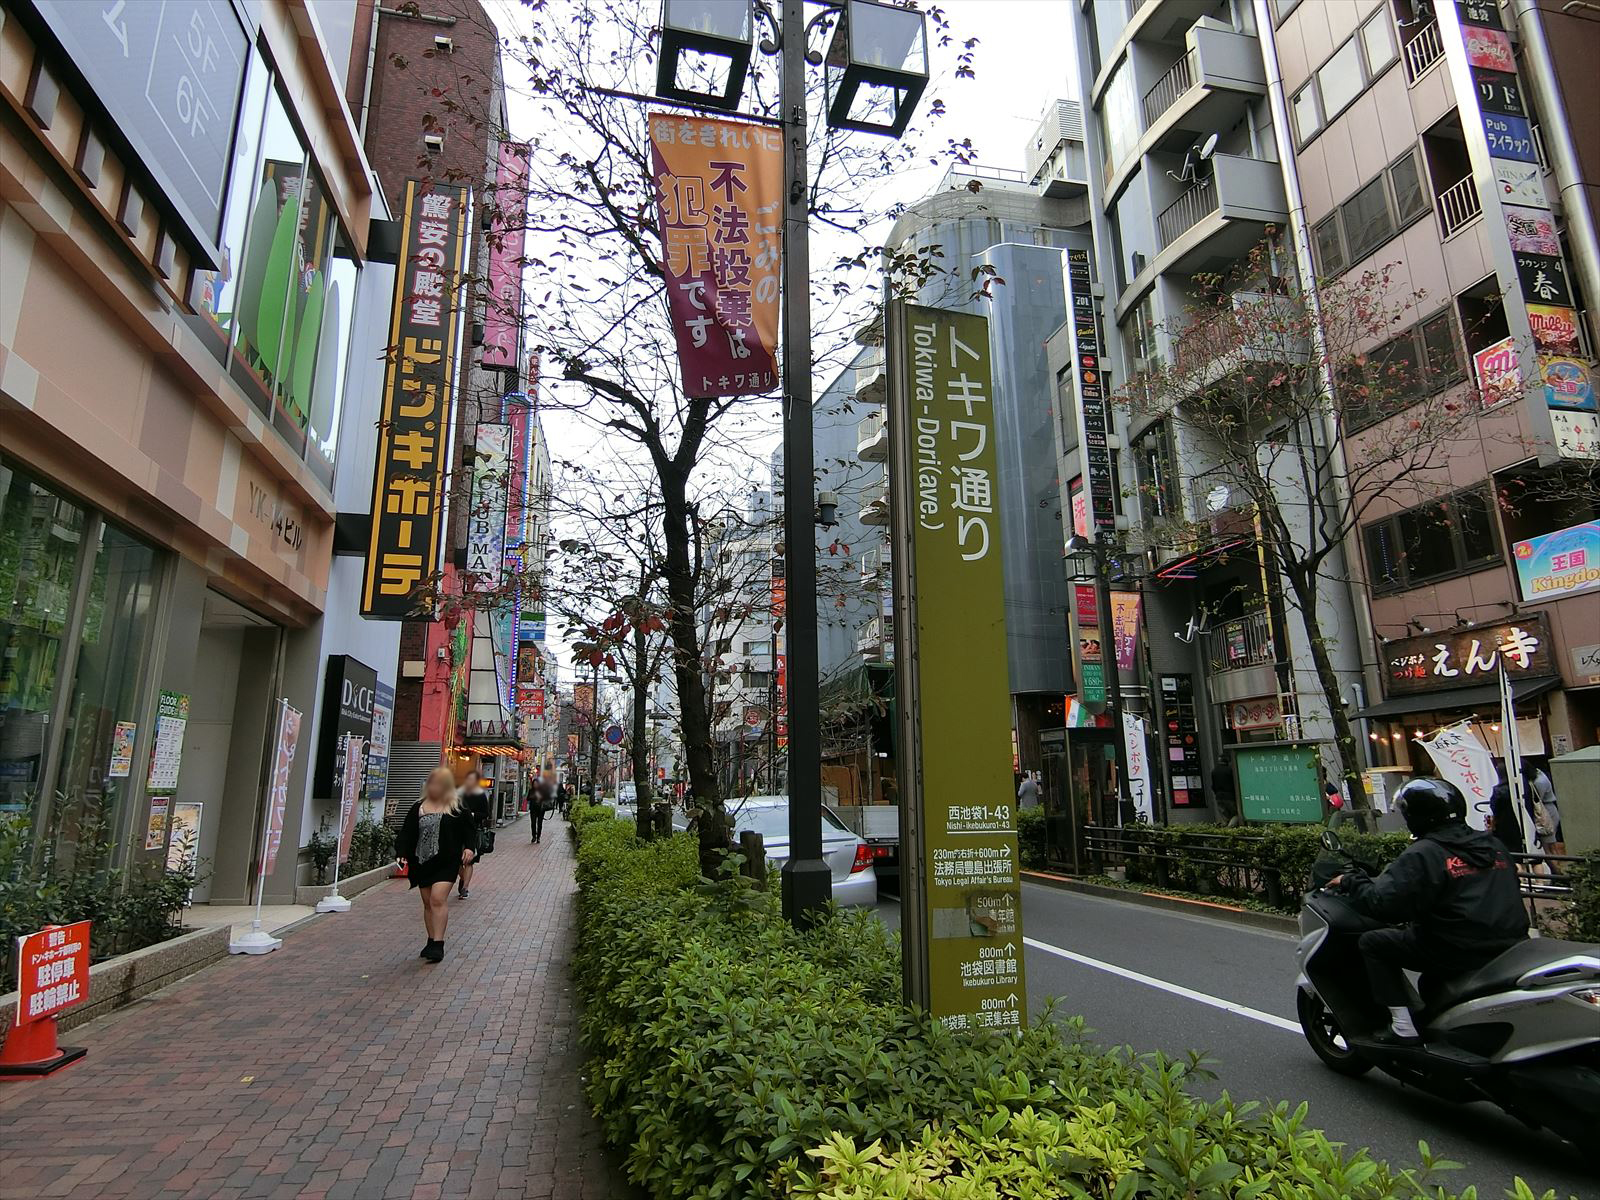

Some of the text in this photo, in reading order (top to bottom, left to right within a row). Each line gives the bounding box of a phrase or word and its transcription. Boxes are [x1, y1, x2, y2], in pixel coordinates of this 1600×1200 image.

[188, 9, 220, 73] 5F
[177, 75, 210, 137] 6F
[1485, 119, 1508, 131] Pub
[654, 121, 780, 152] 街をきれいに
[1487, 133, 1530, 154] ライラック
[410, 193, 452, 327] 驚安の殿堂
[659, 173, 715, 349] 犯罪です
[708, 161, 753, 360] 不法投棄は
[754, 201, 779, 304] ごみの
[1518, 259, 1548, 268] ラウンジ
[1532, 271, 1560, 300] 春
[702, 371, 772, 391] トキワ通り
[946, 326, 993, 562] トキワ通り
[1551, 549, 1586, 573] 王国
[1531, 567, 1600, 594] Kingdo
[1431, 627, 1539, 678] えん寺
[159, 704, 175, 715] GUIDE
[160, 695, 177, 705] FLOOR
[470, 719, 511, 737] MAX
[948, 805, 1010, 820] 西池袋1-43
[934, 859, 1012, 876] 法務局豊島出張所
[935, 878, 952, 887] Tokyo
[953, 877, 970, 887] Legal
[992, 875, 1013, 883] Bureau
[979, 947, 1004, 958] 800m
[37, 957, 75, 988] 駐停車
[960, 959, 1017, 977] 池袋図書館
[963, 976, 1018, 987] Ikebukuro Library
[29, 979, 81, 1017] 駐輪禁止
[981, 998, 1006, 1010] 800m
